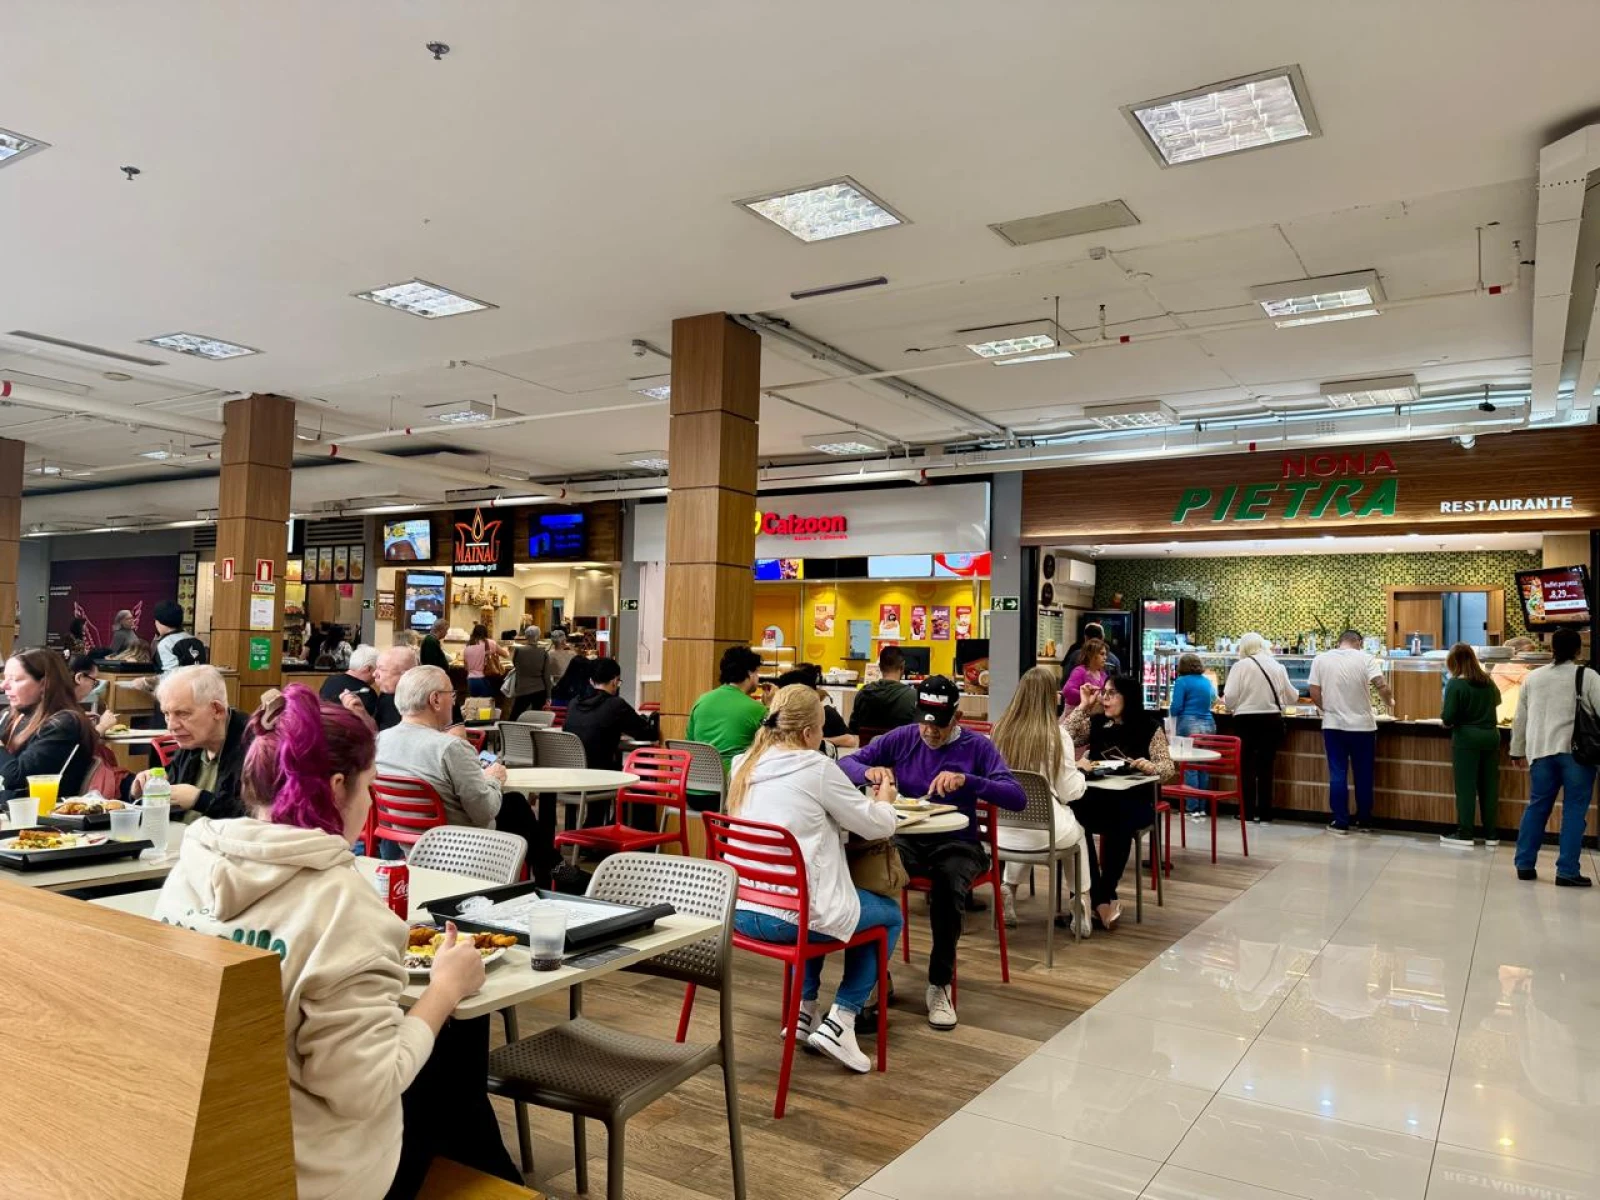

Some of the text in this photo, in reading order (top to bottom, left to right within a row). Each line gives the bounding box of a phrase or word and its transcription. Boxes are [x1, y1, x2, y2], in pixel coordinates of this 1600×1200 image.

[1282, 450, 1398, 478] NONA
[1171, 478, 1398, 524] PIETRA
[1440, 496, 1573, 513] RESTAURANTE
[762, 512, 847, 535] Calzoon
